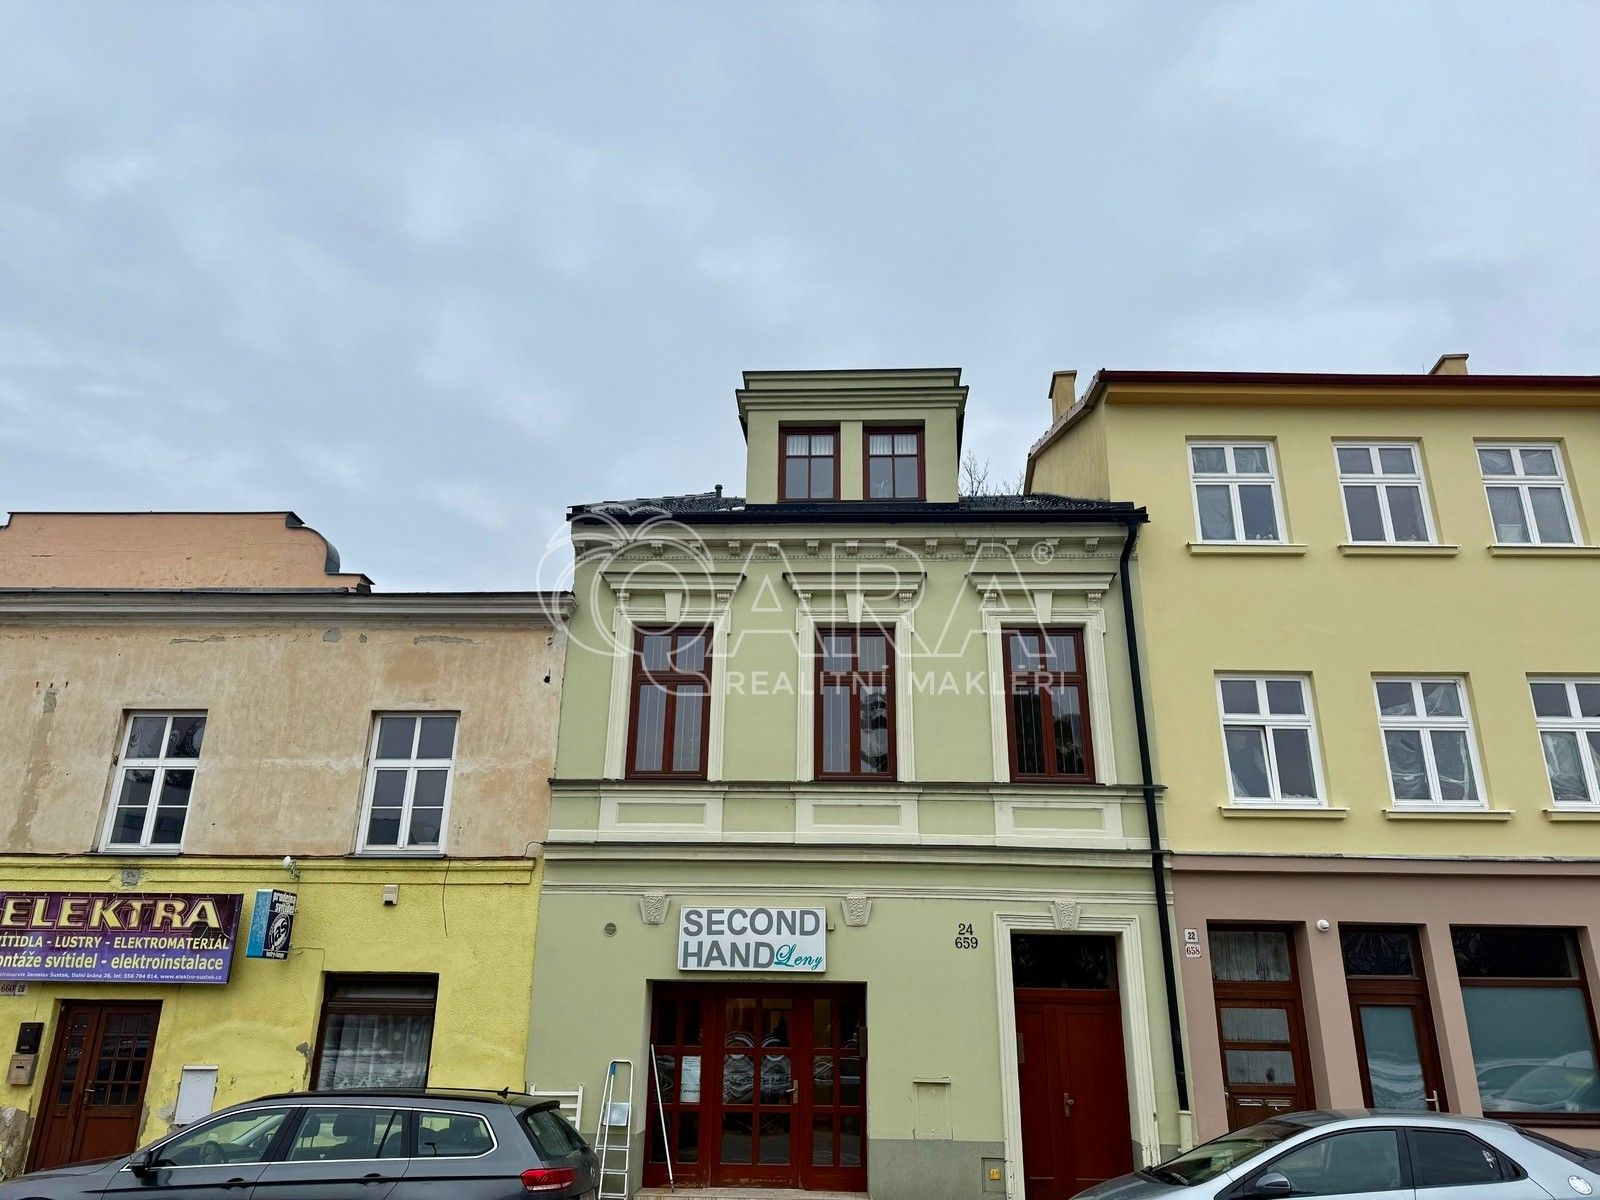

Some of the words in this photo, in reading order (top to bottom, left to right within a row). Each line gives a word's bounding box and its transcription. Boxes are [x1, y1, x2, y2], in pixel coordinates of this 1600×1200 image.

[0, 896, 224, 931] ELEKTRA
[683, 908, 820, 936] SECOND
[958, 923, 974, 935] 24
[55, 936, 102, 948] LUSTRY
[114, 934, 229, 950] ELEKTROMATERIÁL
[955, 936, 978, 949] 659
[1187, 932, 1196, 940] 22
[682, 940, 775, 968] HAND
[774, 944, 823, 970] Leny
[1186, 946, 1200, 956] 658
[44, 952, 98, 968] svítidel
[111, 953, 223, 970] elektroinstalace
